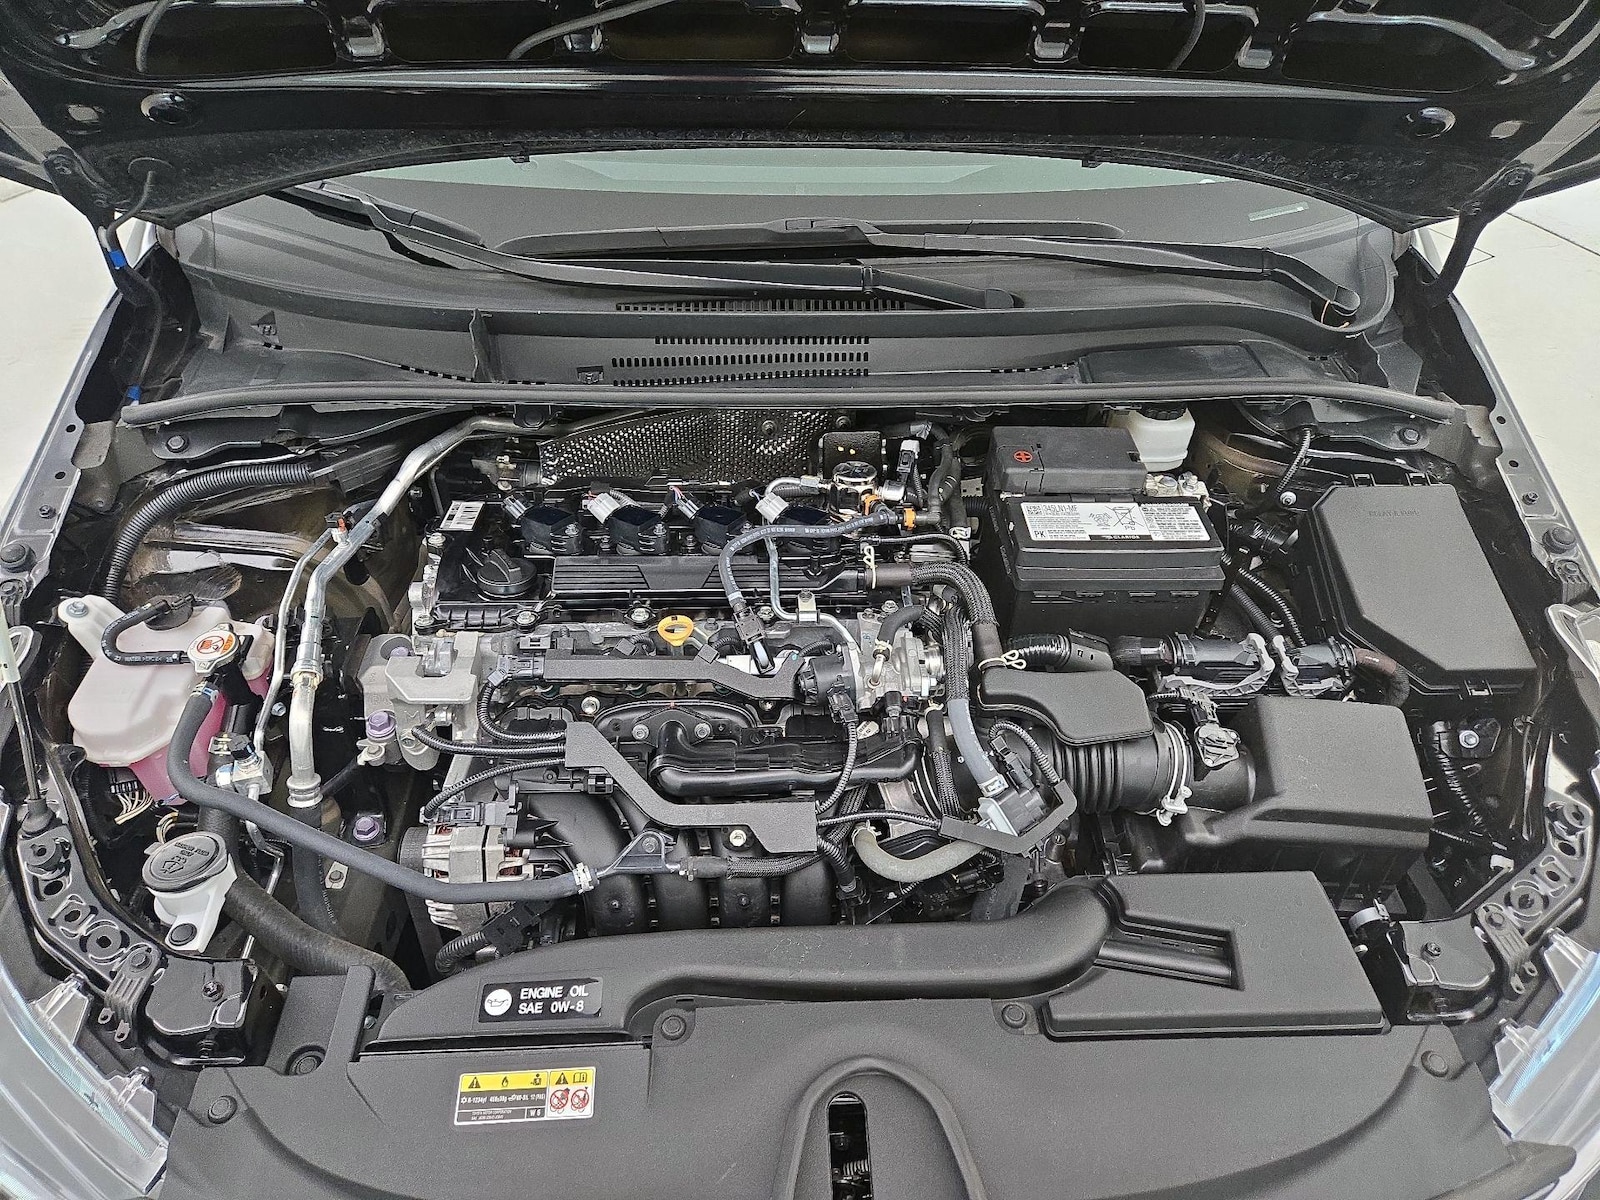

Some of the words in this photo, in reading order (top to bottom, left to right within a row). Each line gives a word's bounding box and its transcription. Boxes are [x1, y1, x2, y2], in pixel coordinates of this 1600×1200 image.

[1034, 530, 1046, 538] PK
[520, 987, 563, 999] ENGINE
[569, 984, 589, 997] OIL
[518, 1002, 543, 1015] SAE
[550, 1000, 584, 1013] 0W-8
